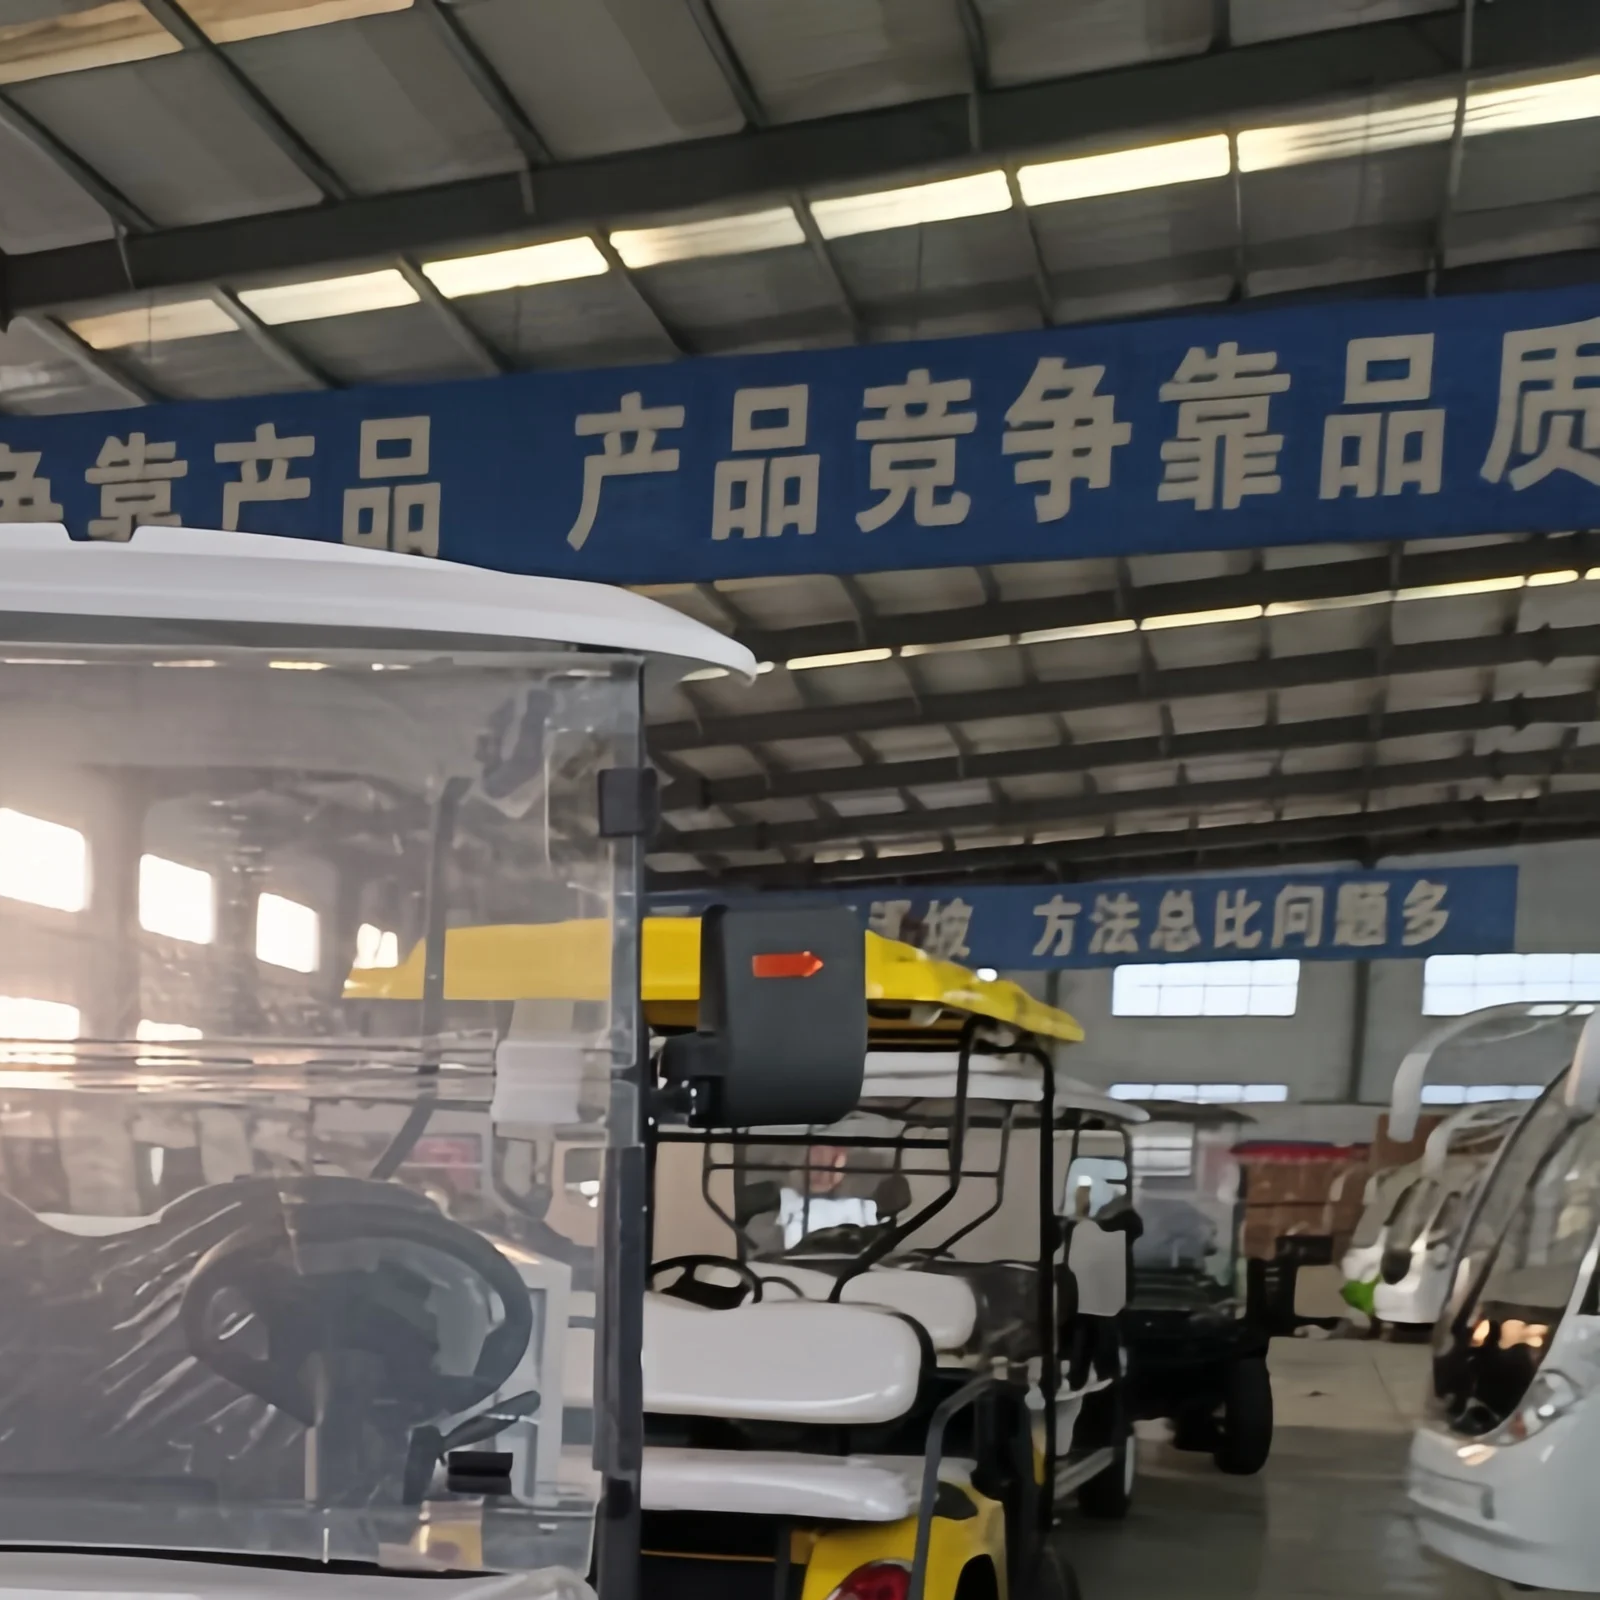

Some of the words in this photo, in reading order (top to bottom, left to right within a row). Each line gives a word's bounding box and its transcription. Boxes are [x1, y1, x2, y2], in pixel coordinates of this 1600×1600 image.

[566, 316, 1600, 551] 产品竞争靠品质
[1032, 879, 1450, 957] 方法总比问题多
